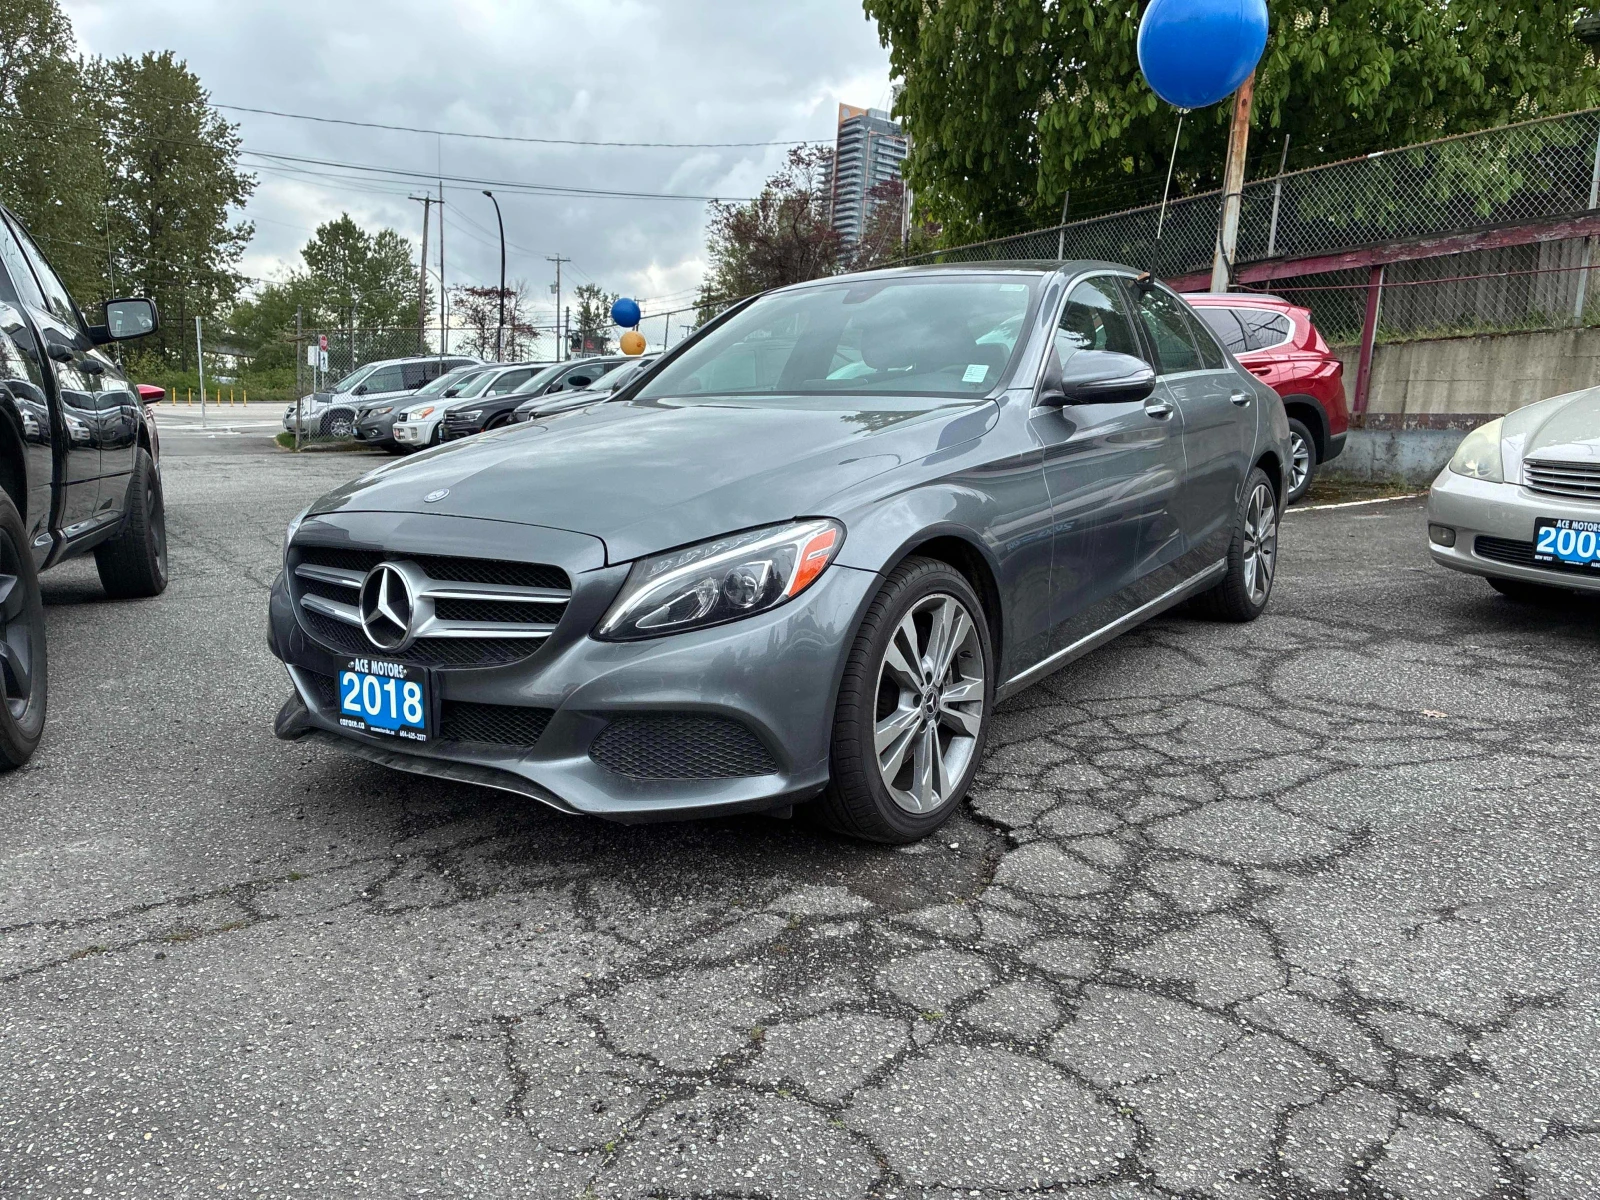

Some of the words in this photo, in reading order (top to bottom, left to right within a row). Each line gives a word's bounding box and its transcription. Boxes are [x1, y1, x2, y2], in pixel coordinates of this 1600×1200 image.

[1556, 519, 1570, 529] ACE
[1537, 527, 1600, 559] 200
[355, 658, 369, 673] ACE
[371, 660, 404, 678] MOTORS
[343, 672, 422, 723] 2018
